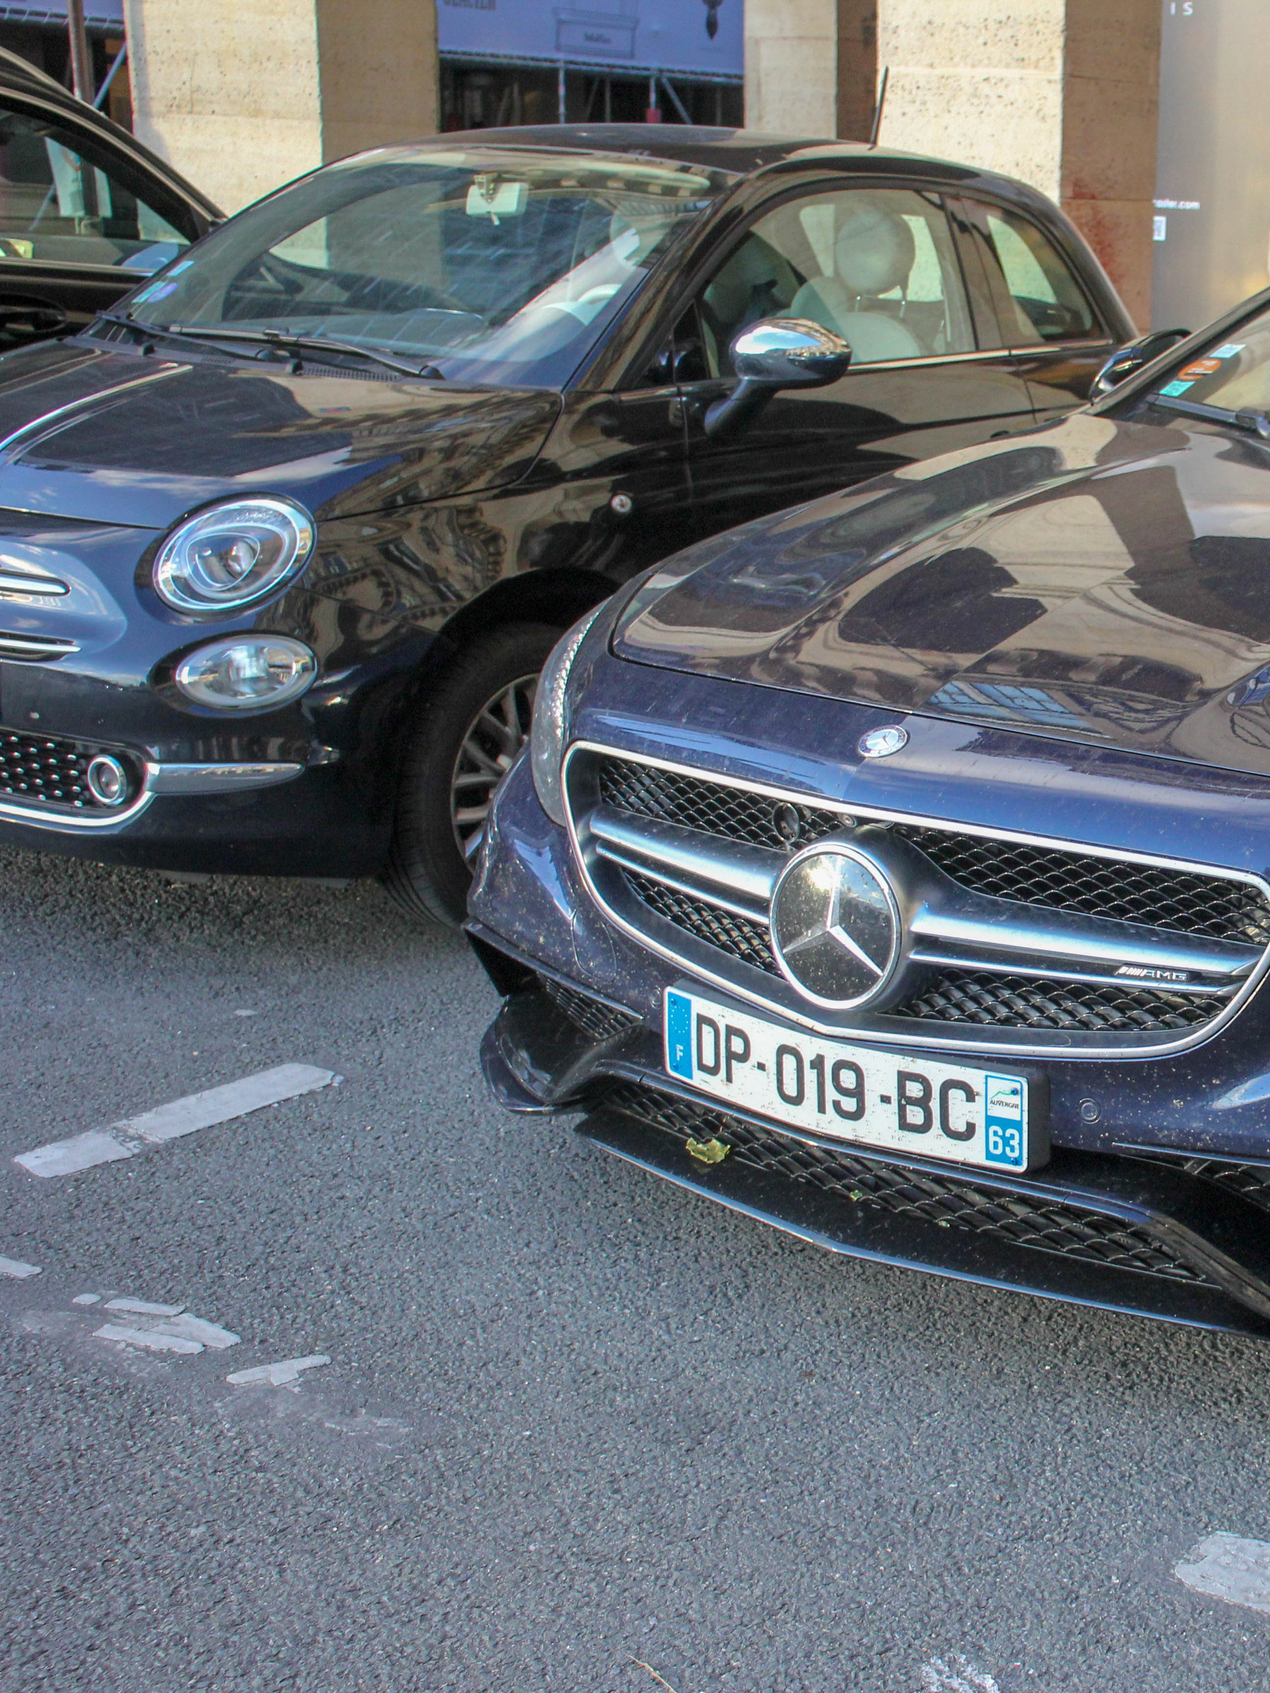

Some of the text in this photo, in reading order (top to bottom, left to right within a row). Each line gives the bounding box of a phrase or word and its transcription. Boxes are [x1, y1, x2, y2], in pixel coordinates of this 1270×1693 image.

[1139, 968, 1188, 981] AMG
[675, 1044, 684, 1061] F
[695, 1012, 977, 1142] DP-019-BC
[989, 1099, 1020, 1110] AUVERGNE
[988, 1125, 1020, 1158] 63
